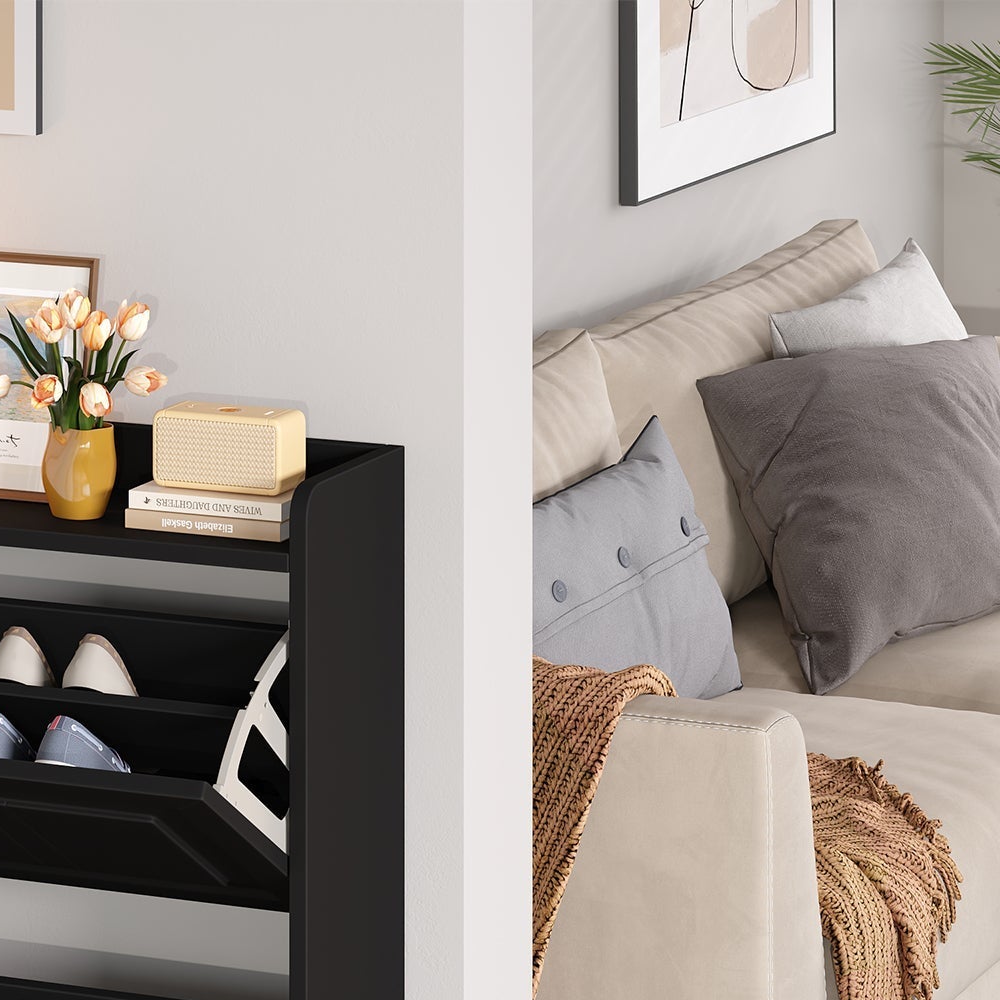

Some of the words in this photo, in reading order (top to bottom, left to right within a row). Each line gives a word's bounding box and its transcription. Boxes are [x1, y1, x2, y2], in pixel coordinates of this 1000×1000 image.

[155, 497, 209, 511] DAUGHTERS
[212, 503, 231, 513] AND
[233, 506, 263, 516] WIVES
[161, 518, 193, 530] Gaskell
[194, 521, 234, 534] Elizabeth
